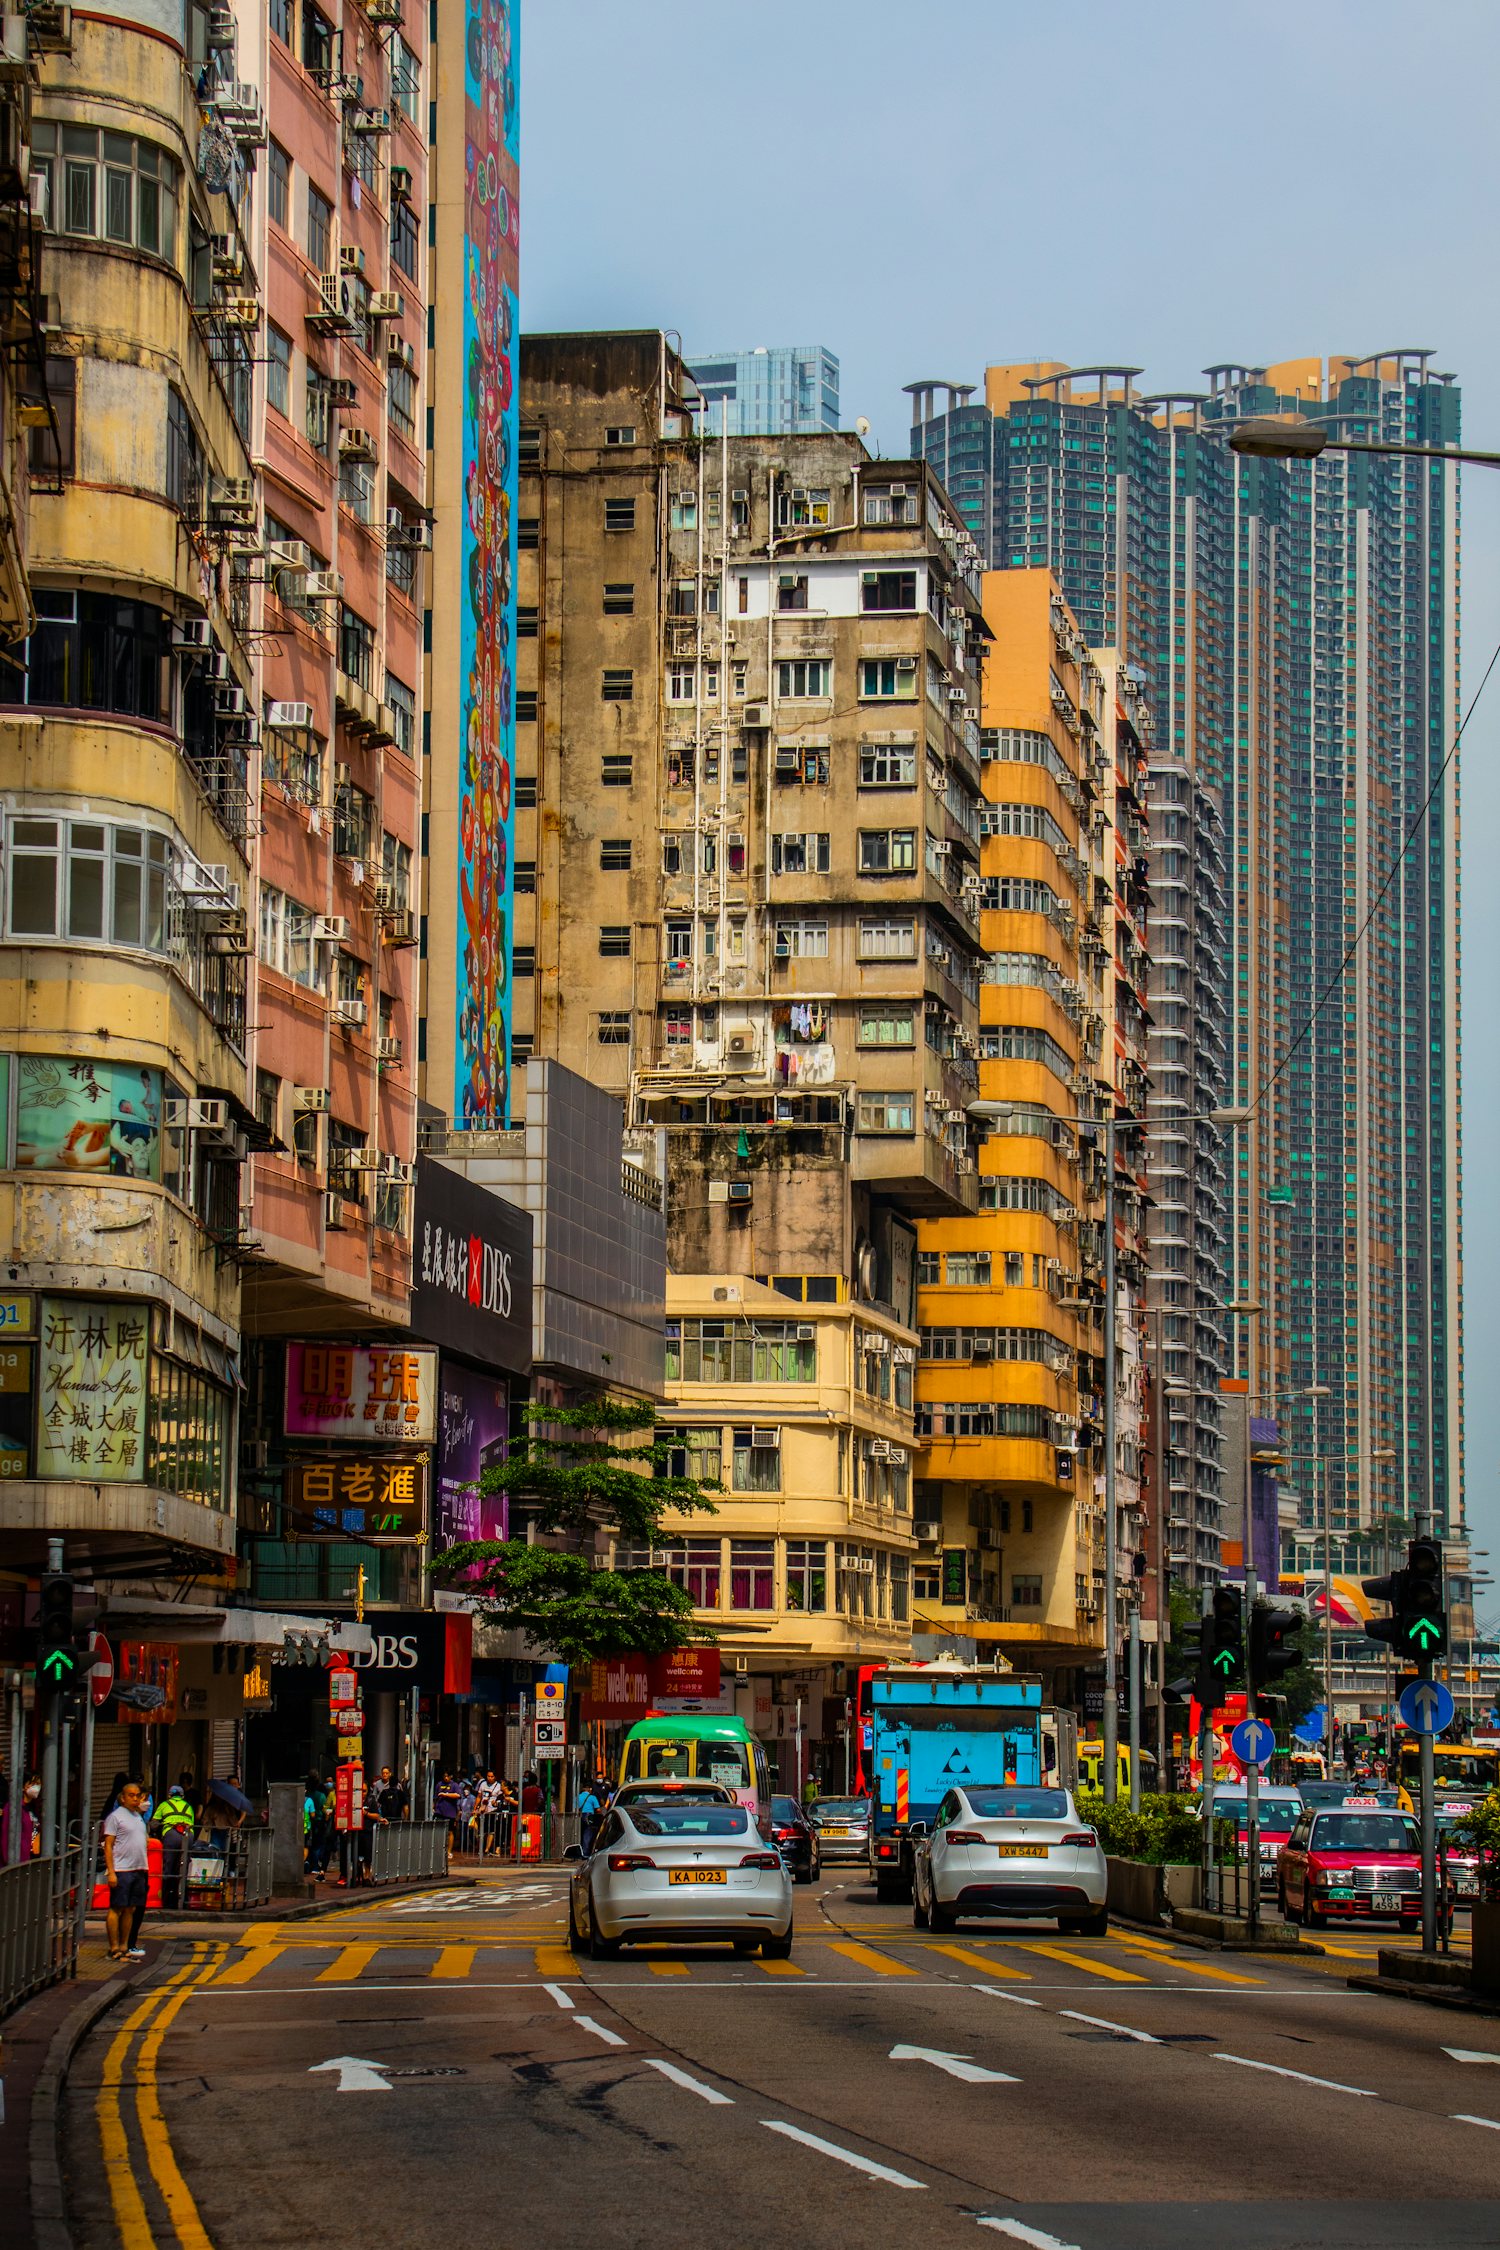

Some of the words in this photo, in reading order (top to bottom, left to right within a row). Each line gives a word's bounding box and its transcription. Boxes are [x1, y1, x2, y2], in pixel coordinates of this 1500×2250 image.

[68, 1063, 110, 1103] 推拿
[482, 1243, 512, 1318] DBS
[303, 1349, 420, 1403] 明珠
[46, 1363, 100, 1393] Hanna
[102, 1369, 141, 1406] Spa
[372, 1514, 403, 1531] 1/F
[352, 1636, 418, 1668] DBS
[671, 1652, 698, 1667] 惠康
[666, 1667, 703, 1676] wellcome
[607, 1664, 648, 1703] wellcome
[666, 1683, 678, 1693] 24
[1004, 1847, 1017, 1855] XW
[1019, 1847, 1043, 1856] 5447
[674, 1872, 690, 1882] KA
[695, 1872, 721, 1882] 1023
[1375, 1901, 1400, 1910] 4593
[1380, 1894, 1393, 1902] VR
